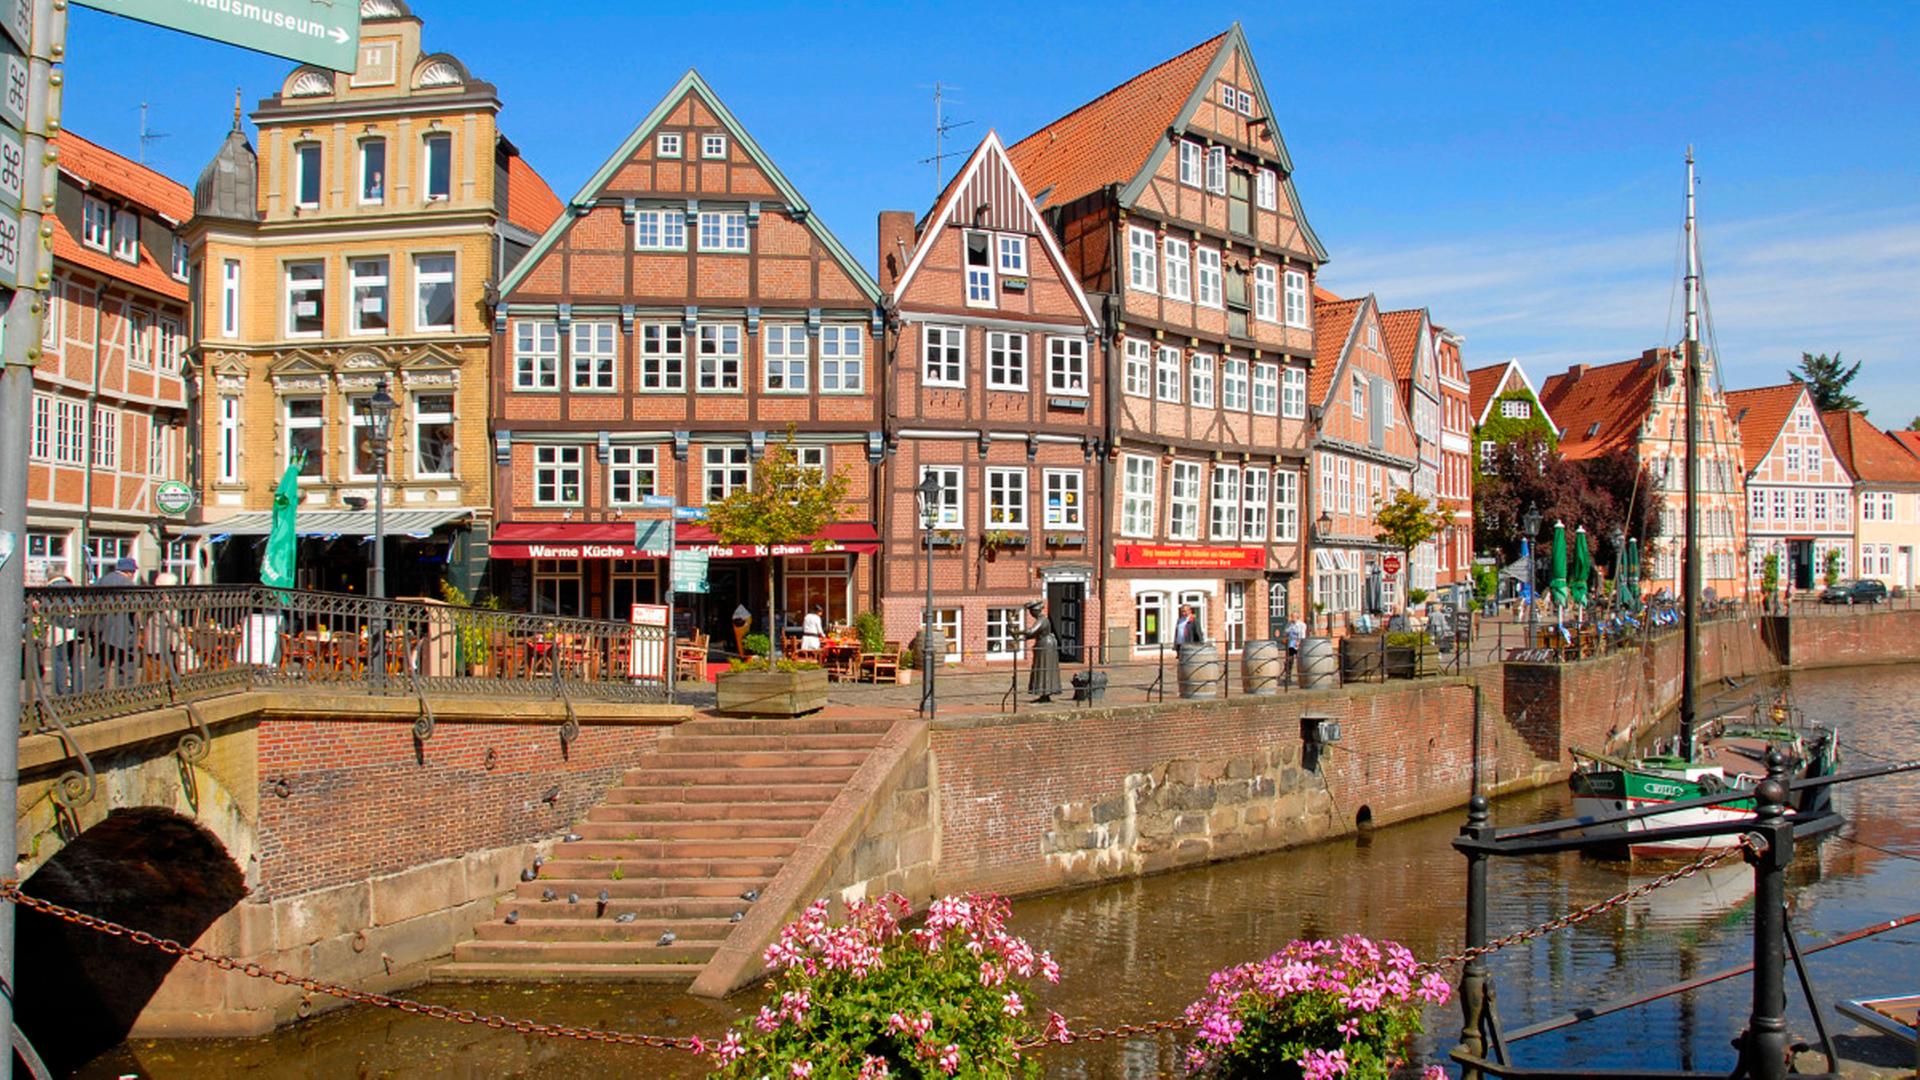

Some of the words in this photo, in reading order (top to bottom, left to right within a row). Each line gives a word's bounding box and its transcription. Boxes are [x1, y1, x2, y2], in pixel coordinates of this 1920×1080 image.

[187, 0, 325, 39] ausmuseum
[529, 545, 579, 557] Warme
[583, 545, 624, 557] Küche
